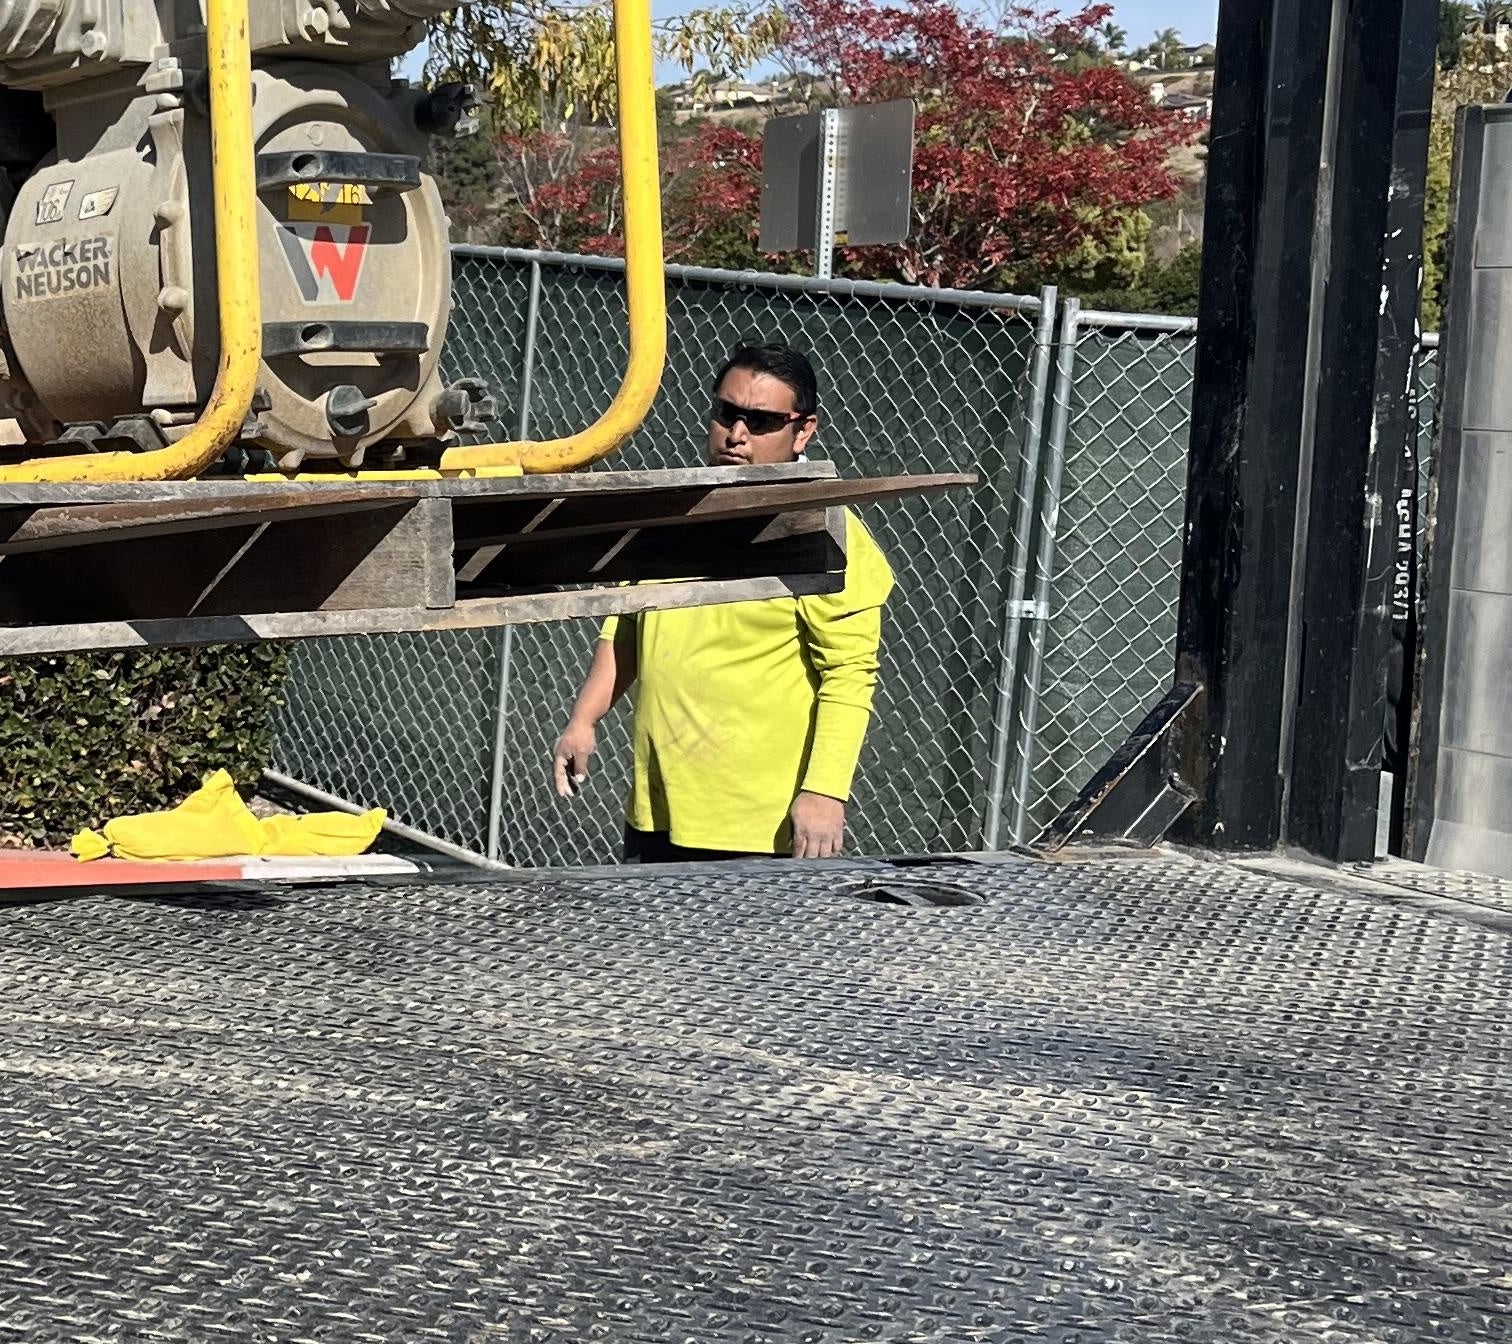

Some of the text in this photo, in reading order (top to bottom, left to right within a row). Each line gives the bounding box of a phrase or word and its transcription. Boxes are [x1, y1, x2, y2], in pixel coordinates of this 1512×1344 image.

[16, 237, 109, 273] WACKER
[275, 225, 370, 302] W
[16, 262, 110, 299] NEUSON
